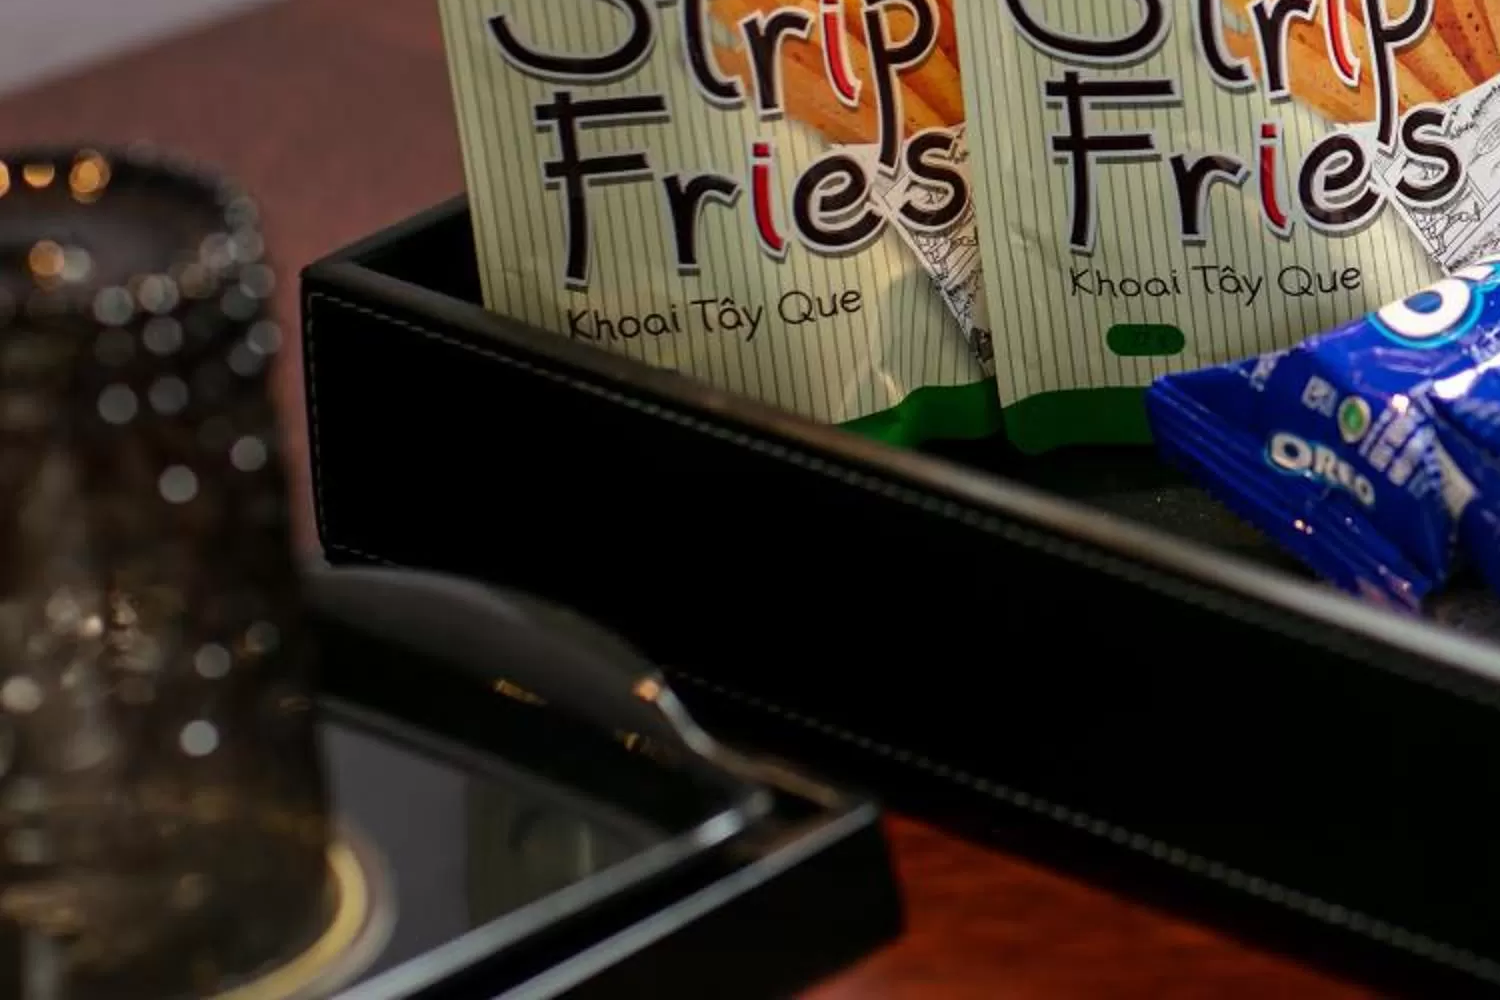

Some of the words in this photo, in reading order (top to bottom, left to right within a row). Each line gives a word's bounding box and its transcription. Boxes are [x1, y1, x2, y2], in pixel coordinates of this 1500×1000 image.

[534, 90, 970, 285] Fries
[1044, 70, 1466, 254] Fries
[567, 304, 682, 341] Khoai
[690, 297, 763, 341] Tây
[778, 289, 862, 325] Que
[1070, 266, 1182, 298] Khoai
[1191, 265, 1263, 306] Tây
[1277, 265, 1361, 298] Que
